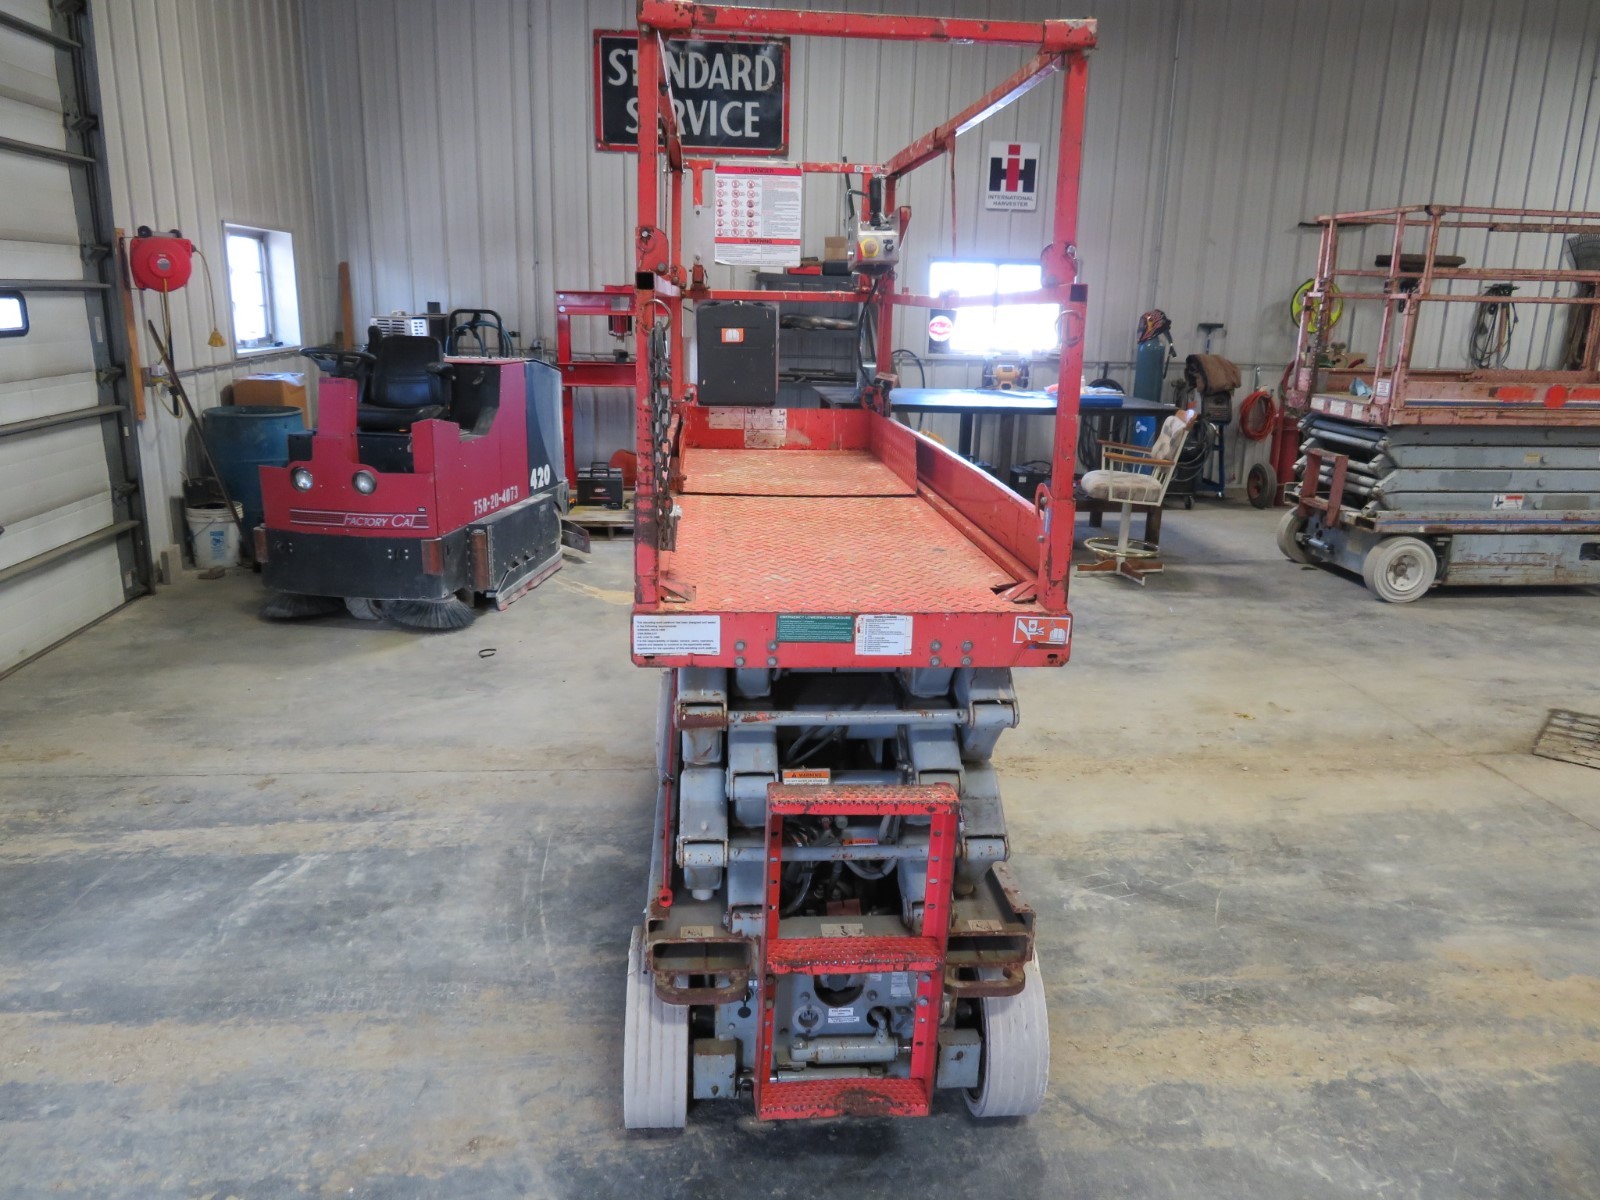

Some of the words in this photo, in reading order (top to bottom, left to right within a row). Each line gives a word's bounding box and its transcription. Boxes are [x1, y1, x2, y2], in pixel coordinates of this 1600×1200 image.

[608, 48, 776, 92] STNDARD
[625, 97, 760, 138] SRVICE
[530, 464, 550, 490] 420
[343, 513, 388, 527] FACTORY
